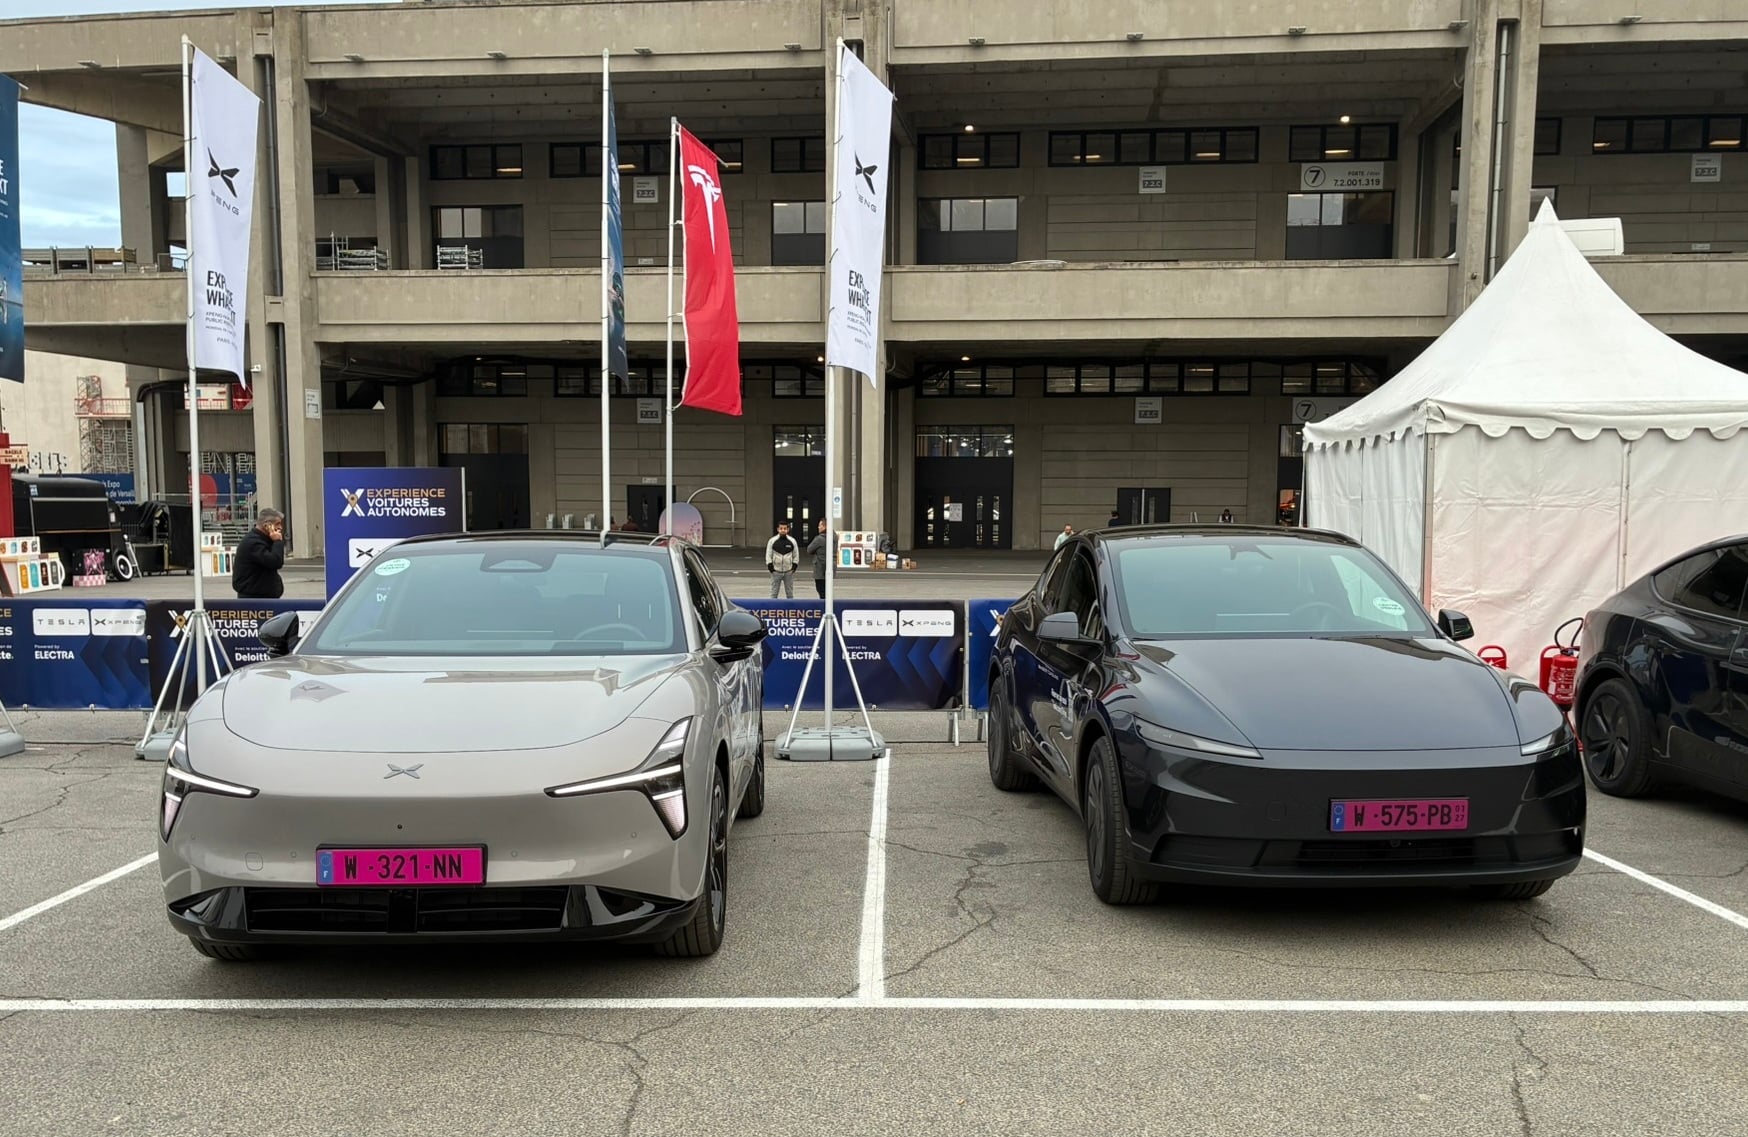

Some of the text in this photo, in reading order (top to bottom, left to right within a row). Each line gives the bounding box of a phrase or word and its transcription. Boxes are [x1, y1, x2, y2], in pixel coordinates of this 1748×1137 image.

[1309, 170, 1321, 184] 7
[1301, 403, 1312, 417] 7
[367, 488, 446, 498] EXPERIENCE
[366, 498, 430, 507] VOITURES
[367, 507, 446, 517] AUTONOMES
[208, 610, 274, 619] PERIENCE
[751, 609, 821, 619] XPERIENCE
[766, 619, 806, 628] TURES
[34, 650, 75, 660] ELECTRA
